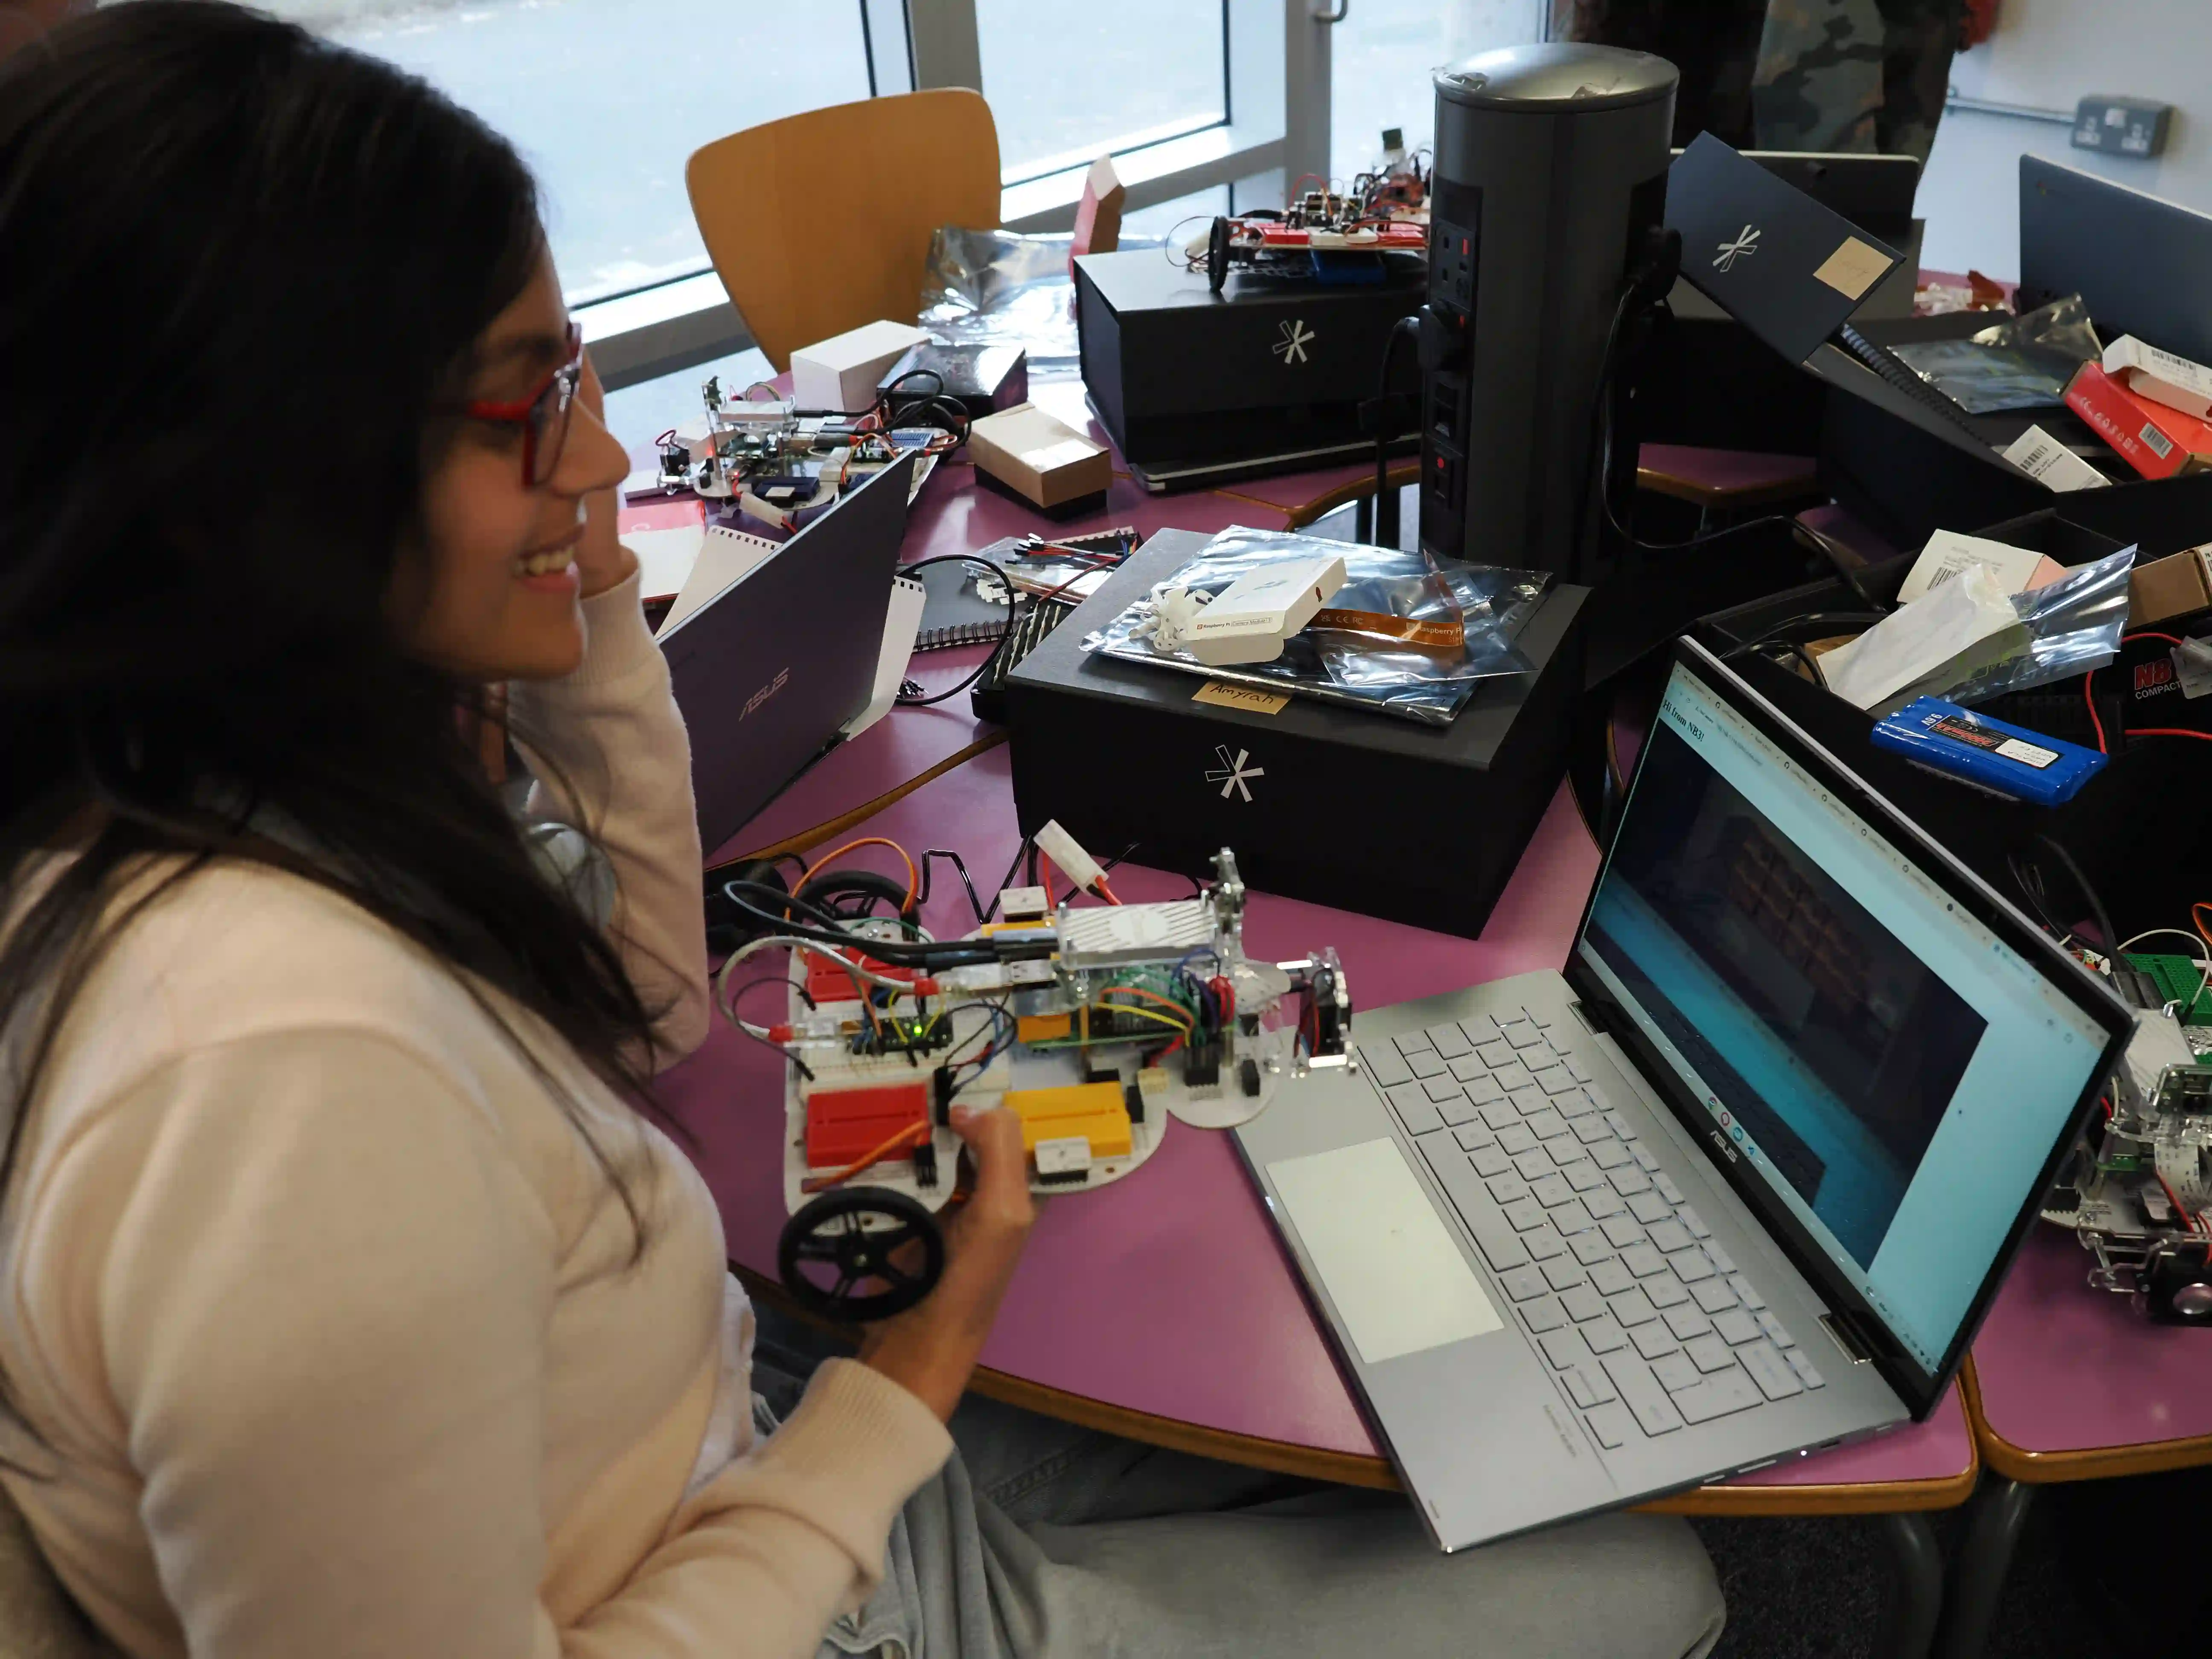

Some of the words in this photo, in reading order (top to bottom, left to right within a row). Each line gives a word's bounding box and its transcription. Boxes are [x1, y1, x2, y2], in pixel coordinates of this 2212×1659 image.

[739, 667, 789, 722] ASUS
[1210, 684, 1273, 704] Amyrah
[1662, 699, 1672, 713] Hi
[1671, 707, 1687, 727] from
[1687, 721, 1705, 742] NB3!
[1921, 713, 1943, 726] 9.6V
[1710, 1130, 1738, 1163] ASUS
